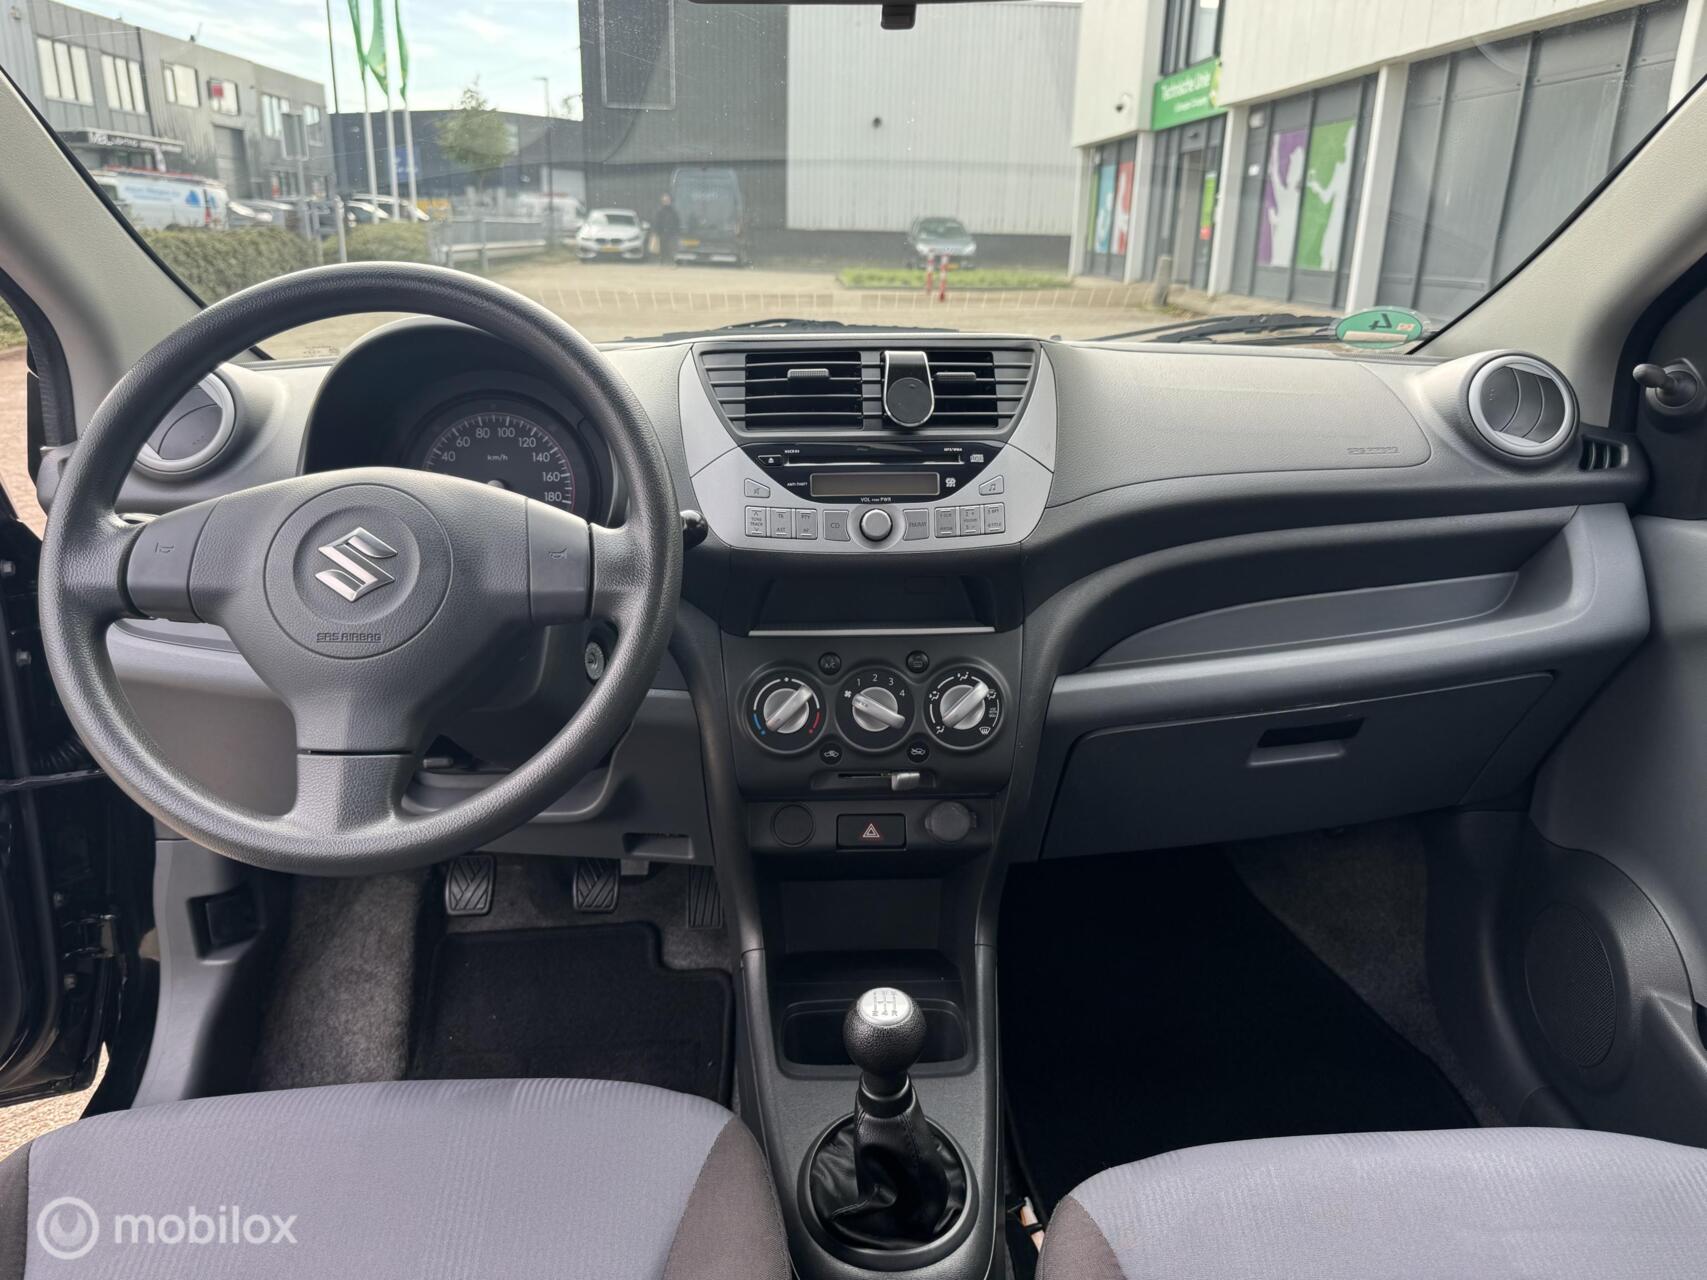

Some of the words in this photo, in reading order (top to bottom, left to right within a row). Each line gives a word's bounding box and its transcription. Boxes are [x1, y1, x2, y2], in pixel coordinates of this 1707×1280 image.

[476, 427, 490, 438] 80
[497, 427, 515, 438] 100
[456, 436, 470, 447] 60
[519, 437, 536, 448] 120
[442, 451, 456, 462] 40
[532, 452, 550, 463] 140
[542, 472, 560, 482] 160
[544, 491, 562, 502] 180
[316, 632, 339, 642] SRS
[341, 632, 382, 642] AIRBAG
[856, 678, 861, 687] 1
[872, 673, 878, 682] 2
[888, 677, 894, 686] 3
[899, 689, 905, 697] 4
